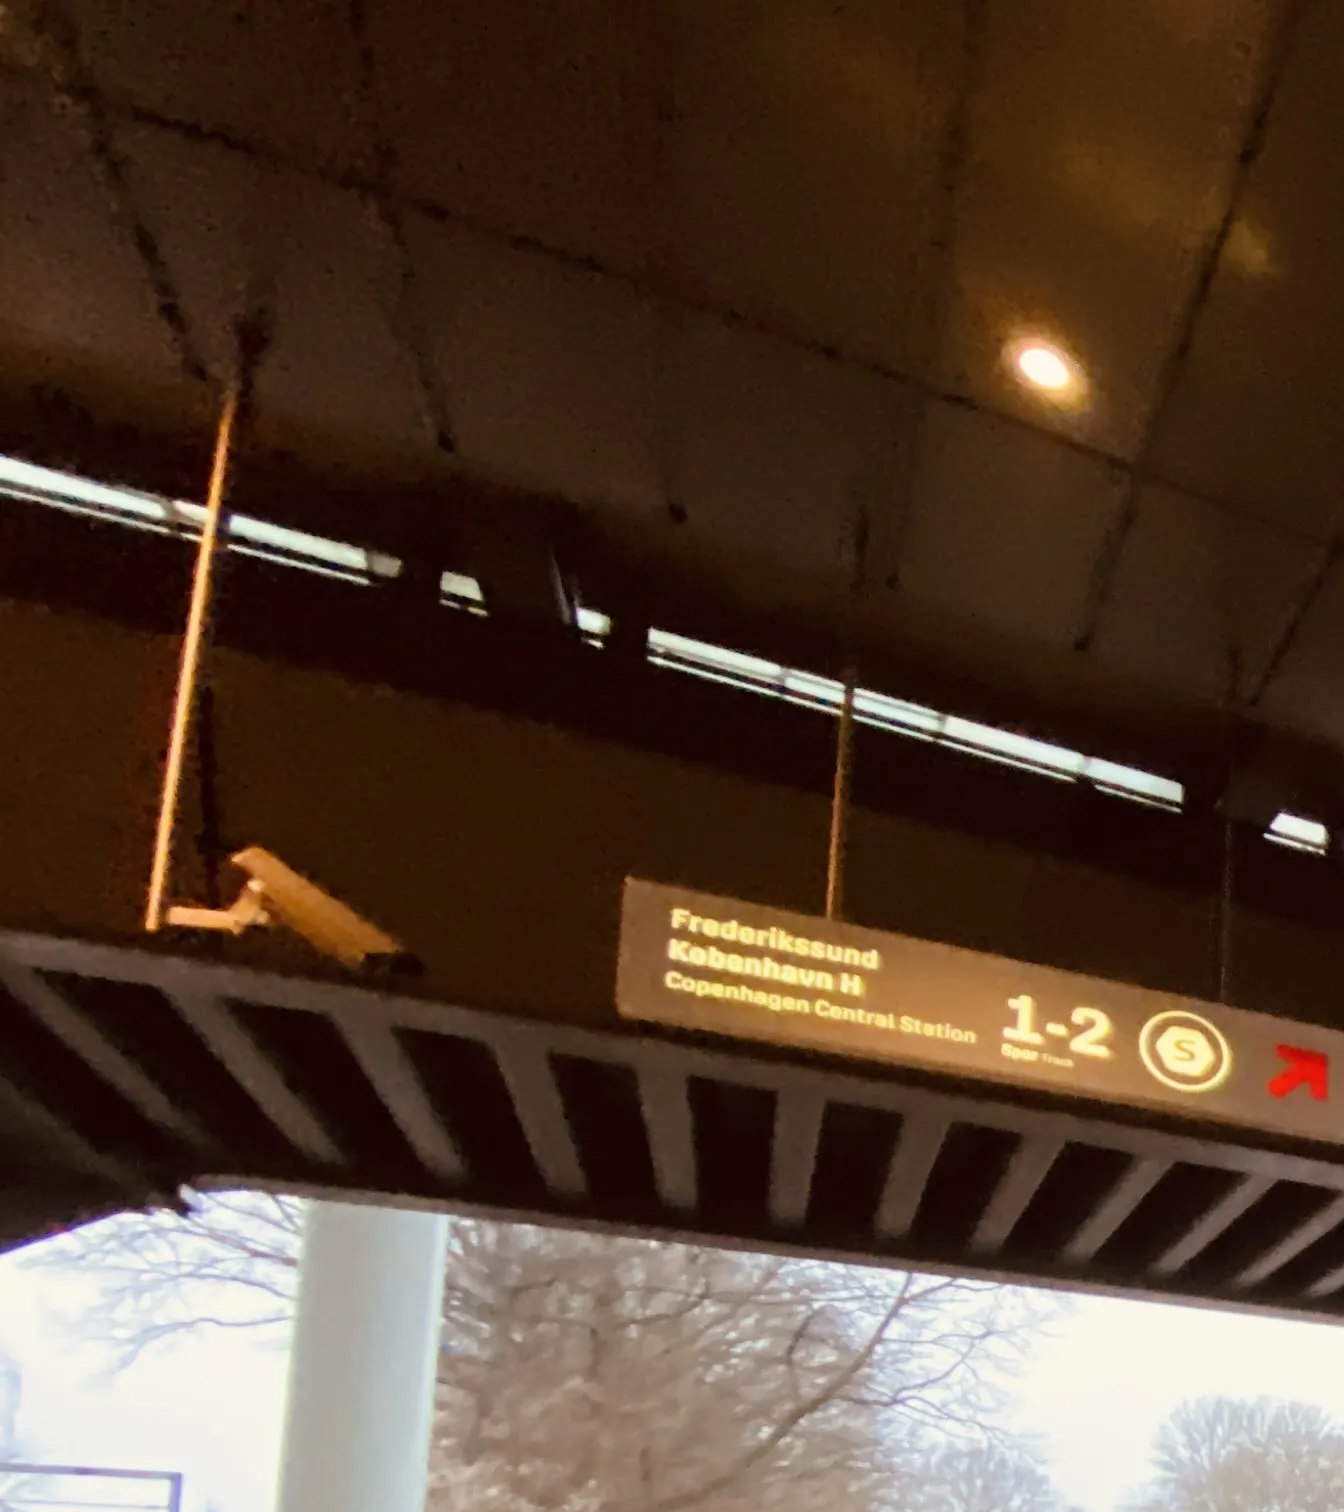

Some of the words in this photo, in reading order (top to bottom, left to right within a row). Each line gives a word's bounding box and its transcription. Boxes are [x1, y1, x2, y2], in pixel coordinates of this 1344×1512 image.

[670, 908, 880, 970] Frederikssund
[664, 971, 811, 1012] Copenhagen
[814, 999, 896, 1030] Central
[899, 1015, 977, 1044] Station
[840, 972, 862, 997] H
[1002, 995, 1113, 1058] 1-2
